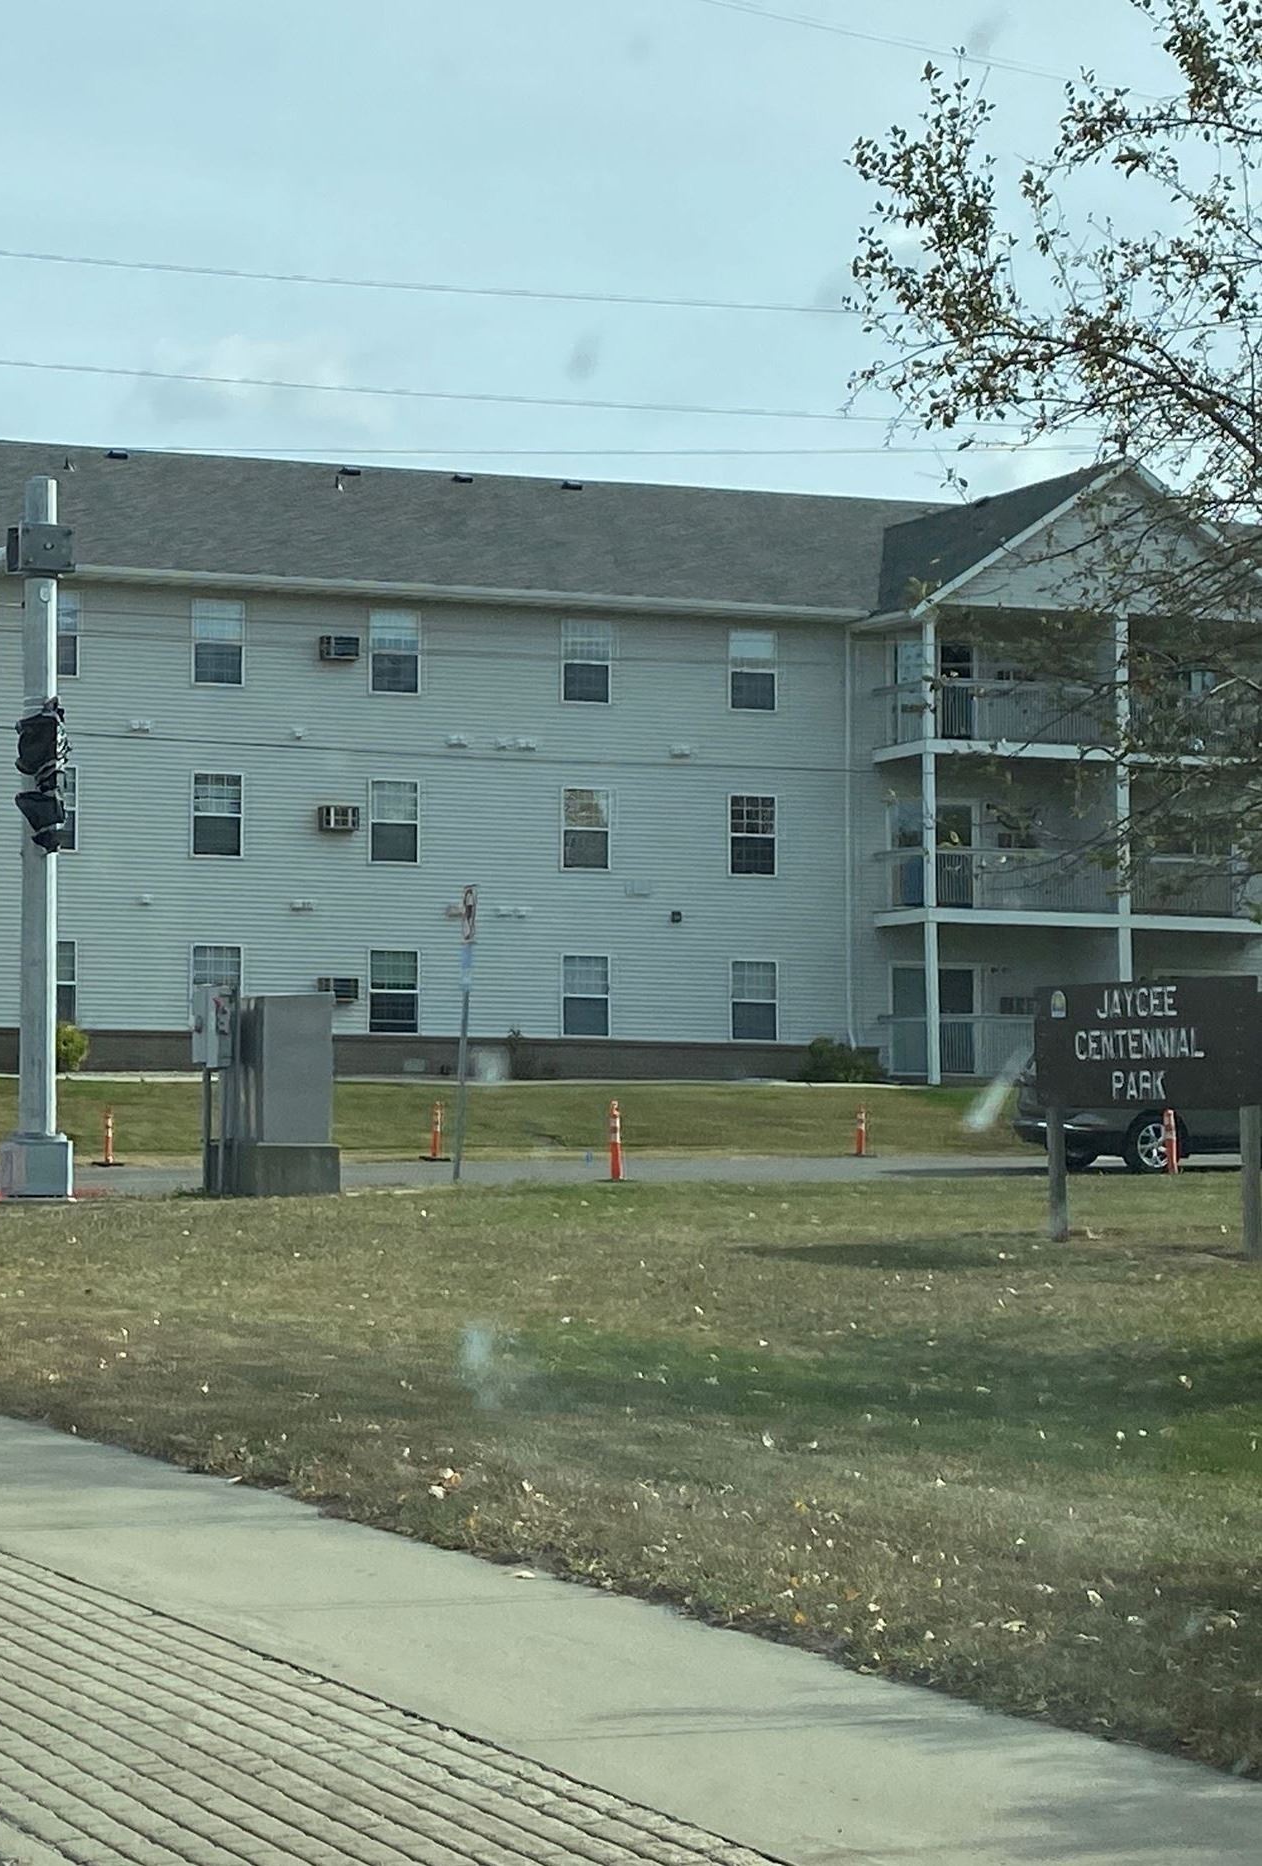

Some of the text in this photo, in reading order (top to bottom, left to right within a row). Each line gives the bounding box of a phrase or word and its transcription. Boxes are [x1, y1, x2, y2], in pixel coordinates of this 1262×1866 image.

[1096, 985, 1178, 1019] JAYCEE
[1075, 1026, 1205, 1061] CENTENNIAL
[1111, 1070, 1167, 1100] PARK
